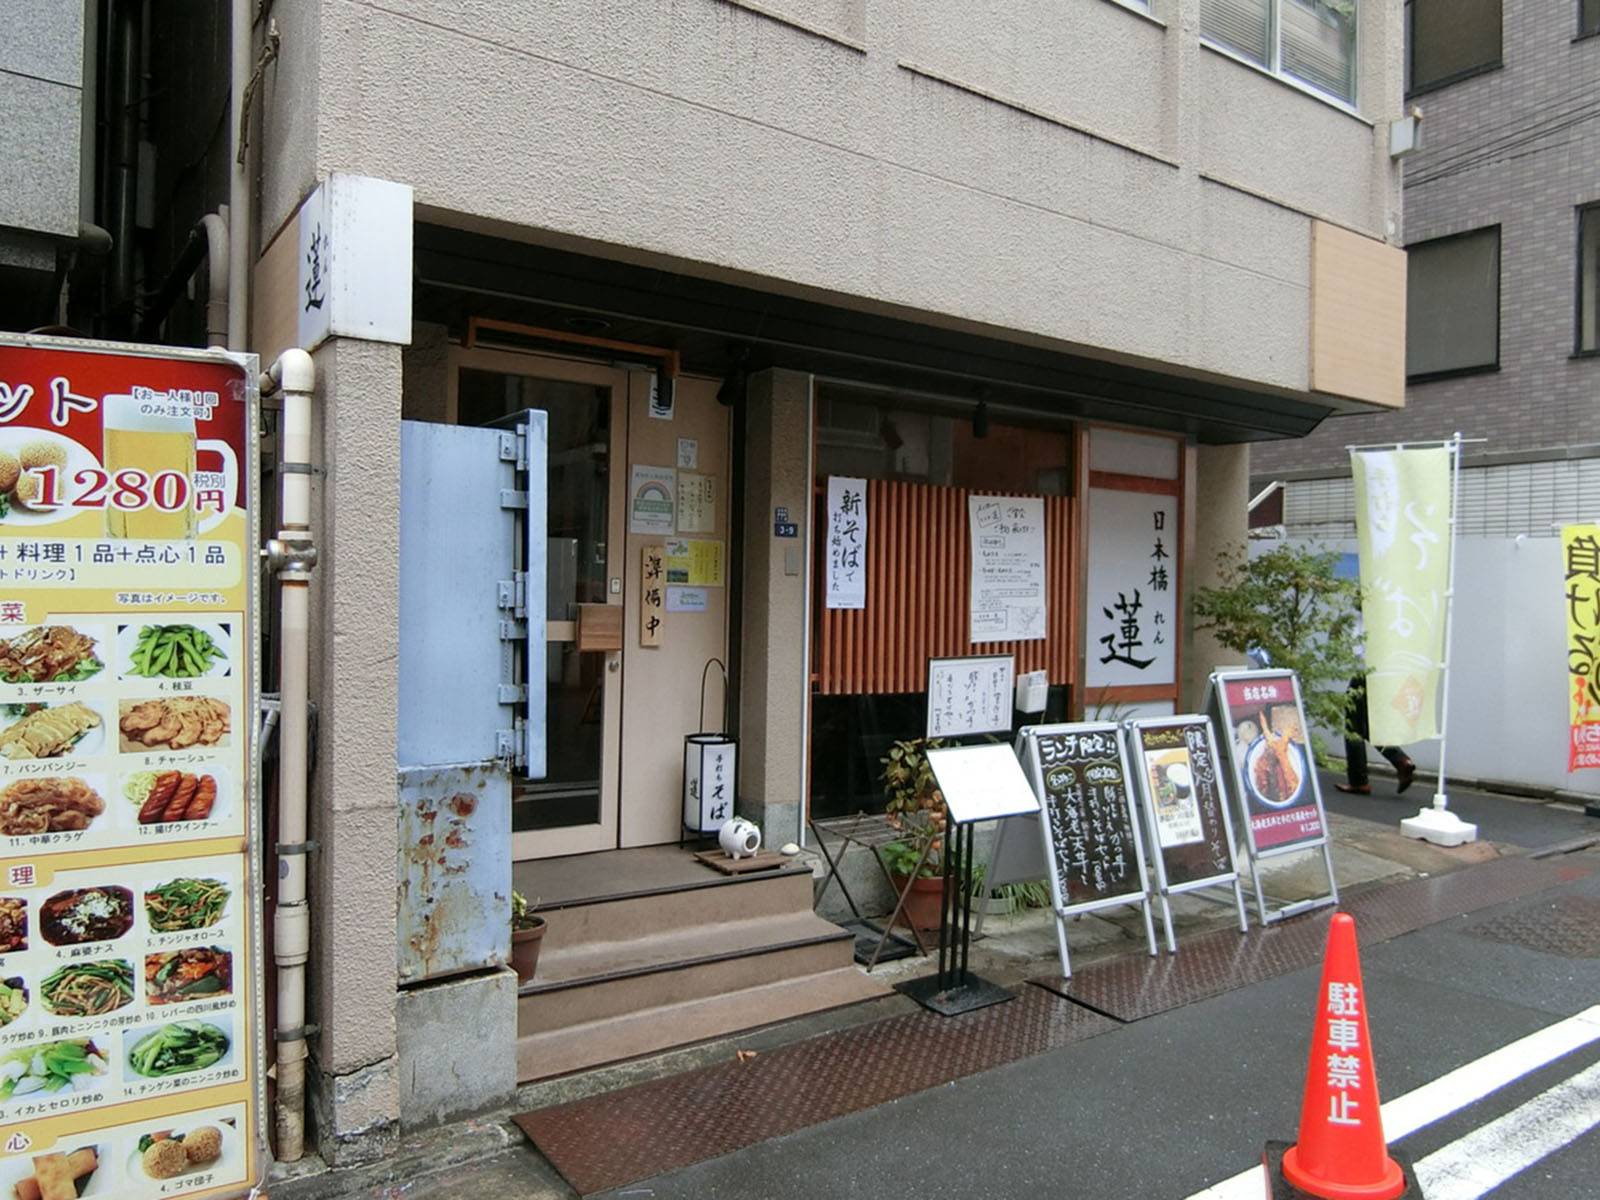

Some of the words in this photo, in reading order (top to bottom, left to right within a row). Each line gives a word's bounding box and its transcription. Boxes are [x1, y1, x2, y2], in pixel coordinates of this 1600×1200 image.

[30, 468, 188, 510] 1280
[194, 474, 226, 489] 税別
[196, 490, 225, 513] 円
[1147, 511, 1169, 592] 日本橋
[643, 553, 663, 639] 準備中
[1, 602, 24, 622] 菜
[1098, 588, 1157, 670] 蓮
[1153, 611, 1165, 645] れん
[33, 685, 77, 696] ザーサイ
[172, 681, 193, 691] 枝豆
[157, 753, 216, 766] チャーシュー
[29, 831, 84, 846] 中華クラゲ
[11, 866, 34, 883] 理
[159, 929, 225, 945] チンジャオロース
[70, 944, 114, 958] 麻婆ナス
[1327, 981, 1361, 1126] 駐車禁止
[139, 1068, 240, 1095] チンゲン菜のニンニク炒め
[14, 1093, 104, 1117] イカとセロリ炒め
[7, 1132, 30, 1151] 心
